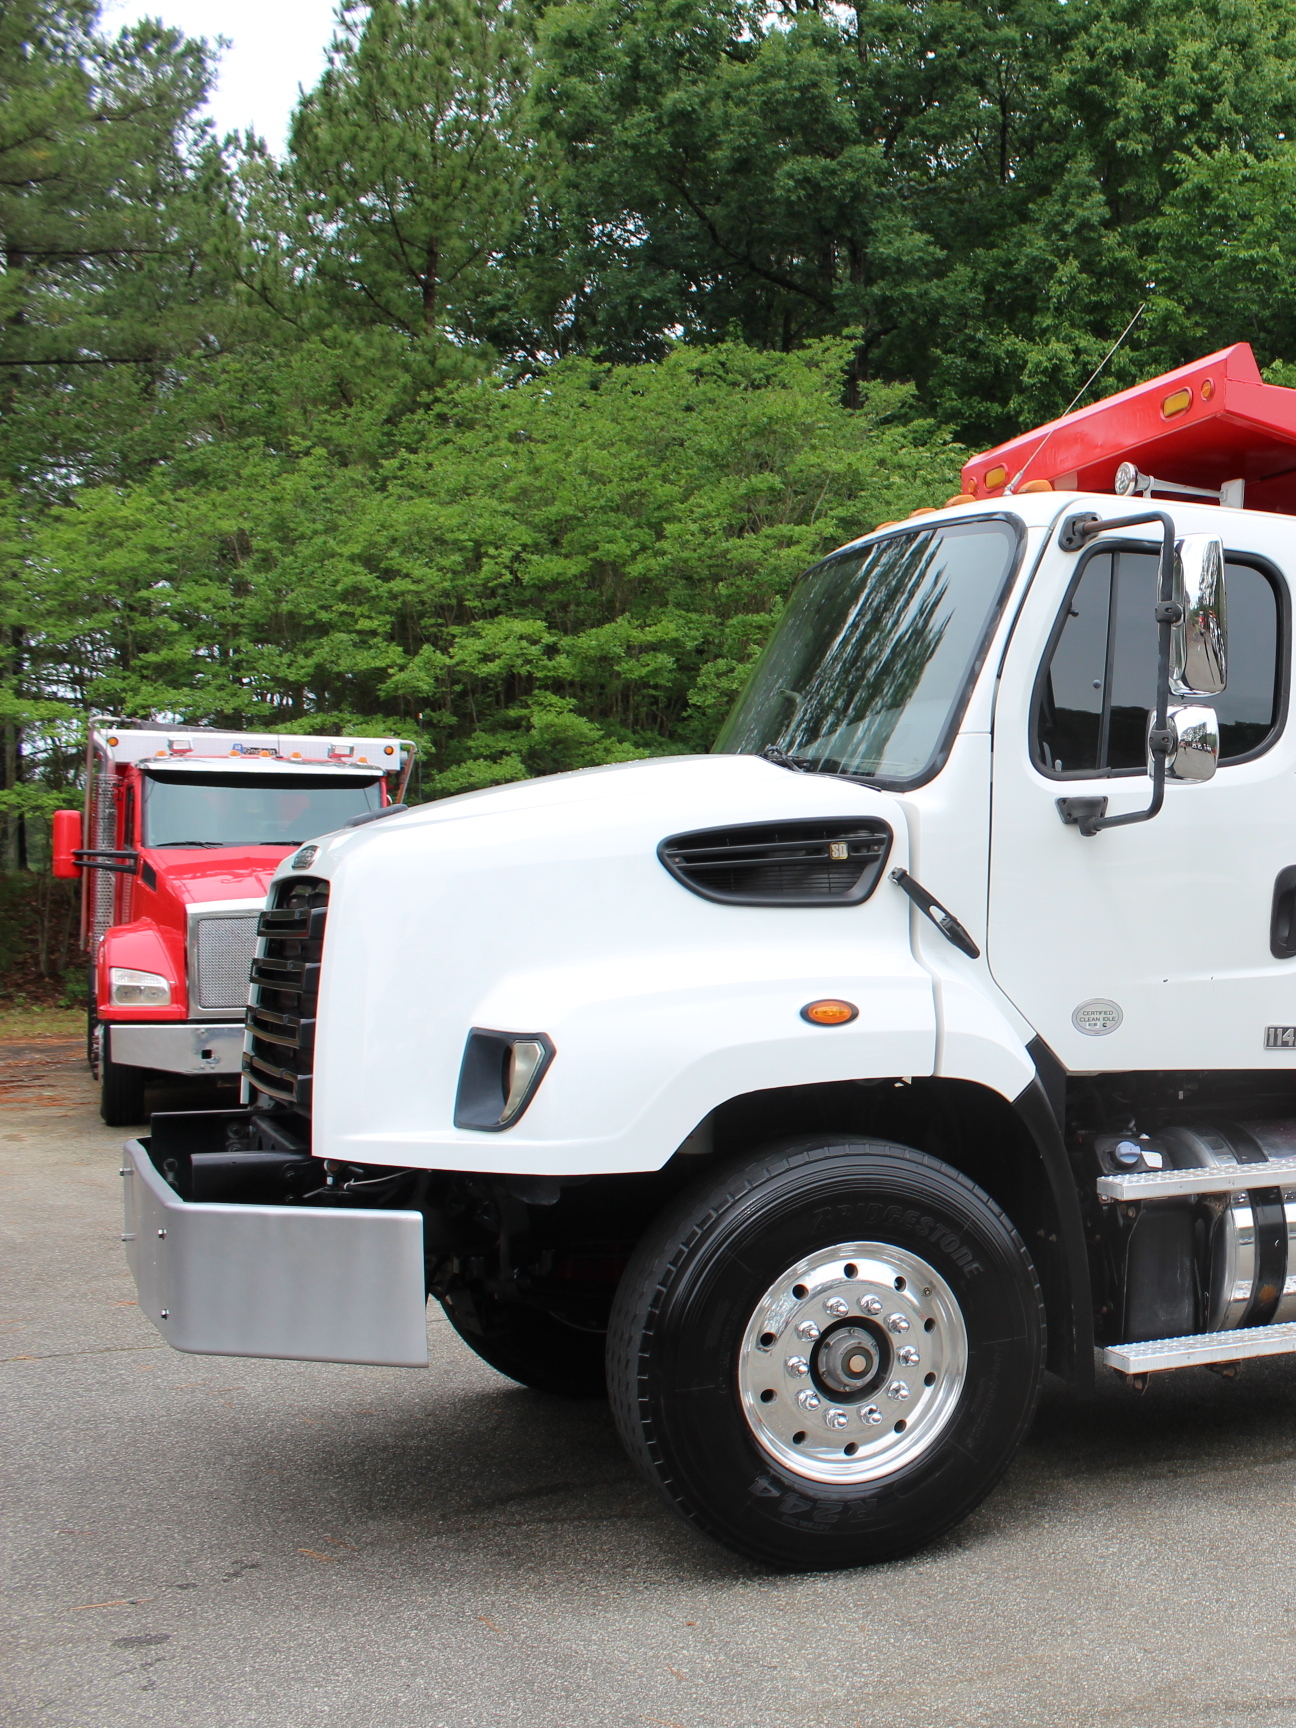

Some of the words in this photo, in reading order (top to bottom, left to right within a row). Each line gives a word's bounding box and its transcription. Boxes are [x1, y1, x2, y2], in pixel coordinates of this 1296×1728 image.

[831, 843, 848, 858] SD
[1268, 1028, 1295, 1046] 114
[811, 1202, 984, 1279] BRIDGESTONE
[748, 1475, 877, 1523] R244
